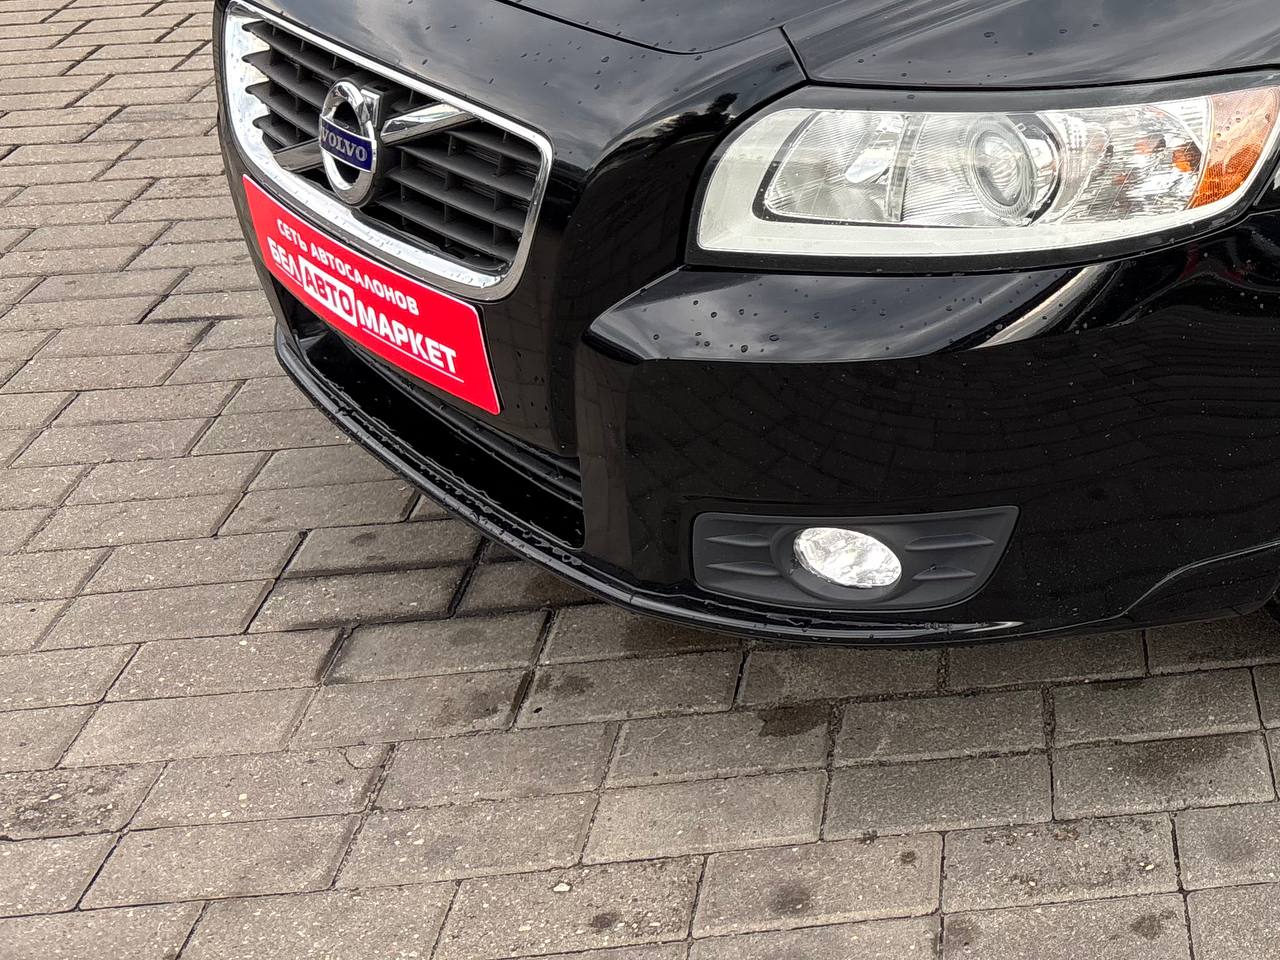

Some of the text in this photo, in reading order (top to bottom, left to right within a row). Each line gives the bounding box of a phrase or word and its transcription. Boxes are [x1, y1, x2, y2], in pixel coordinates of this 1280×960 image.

[320, 126, 368, 161] VOLVO
[277, 219, 420, 316] СЕТЬ АВТОСАЛОНОВ
